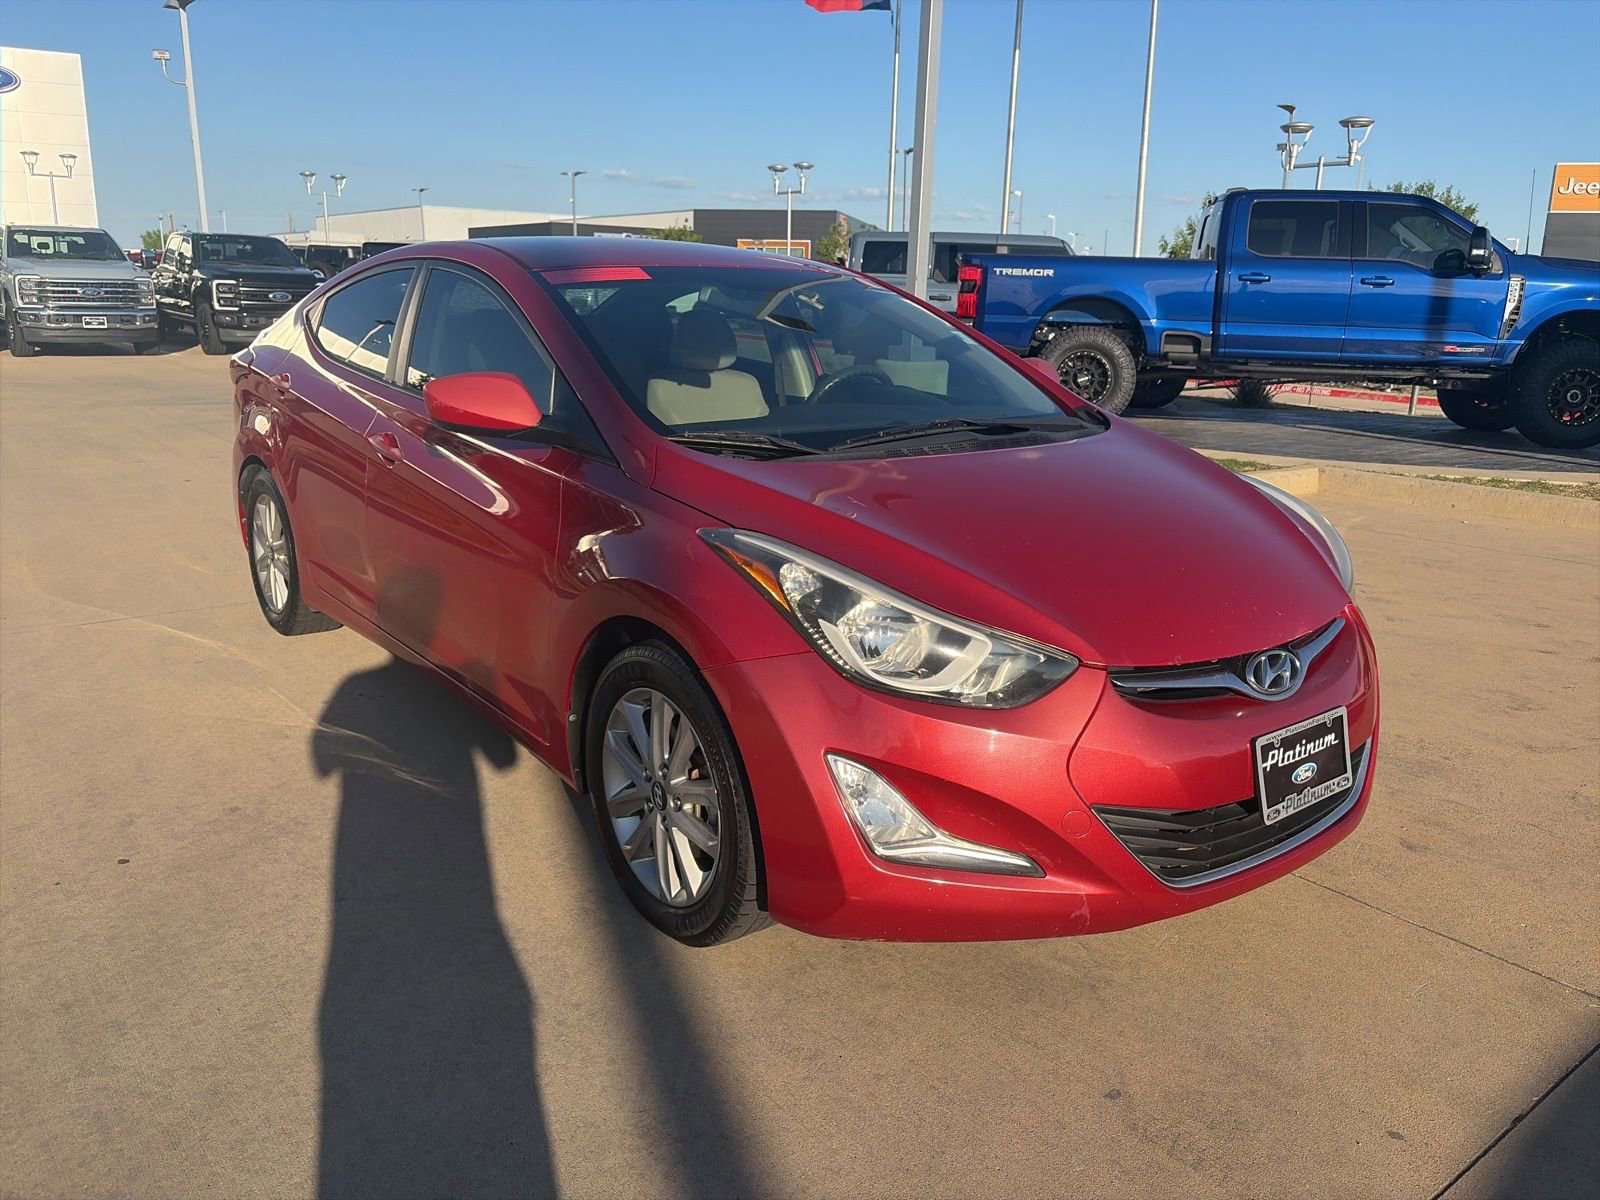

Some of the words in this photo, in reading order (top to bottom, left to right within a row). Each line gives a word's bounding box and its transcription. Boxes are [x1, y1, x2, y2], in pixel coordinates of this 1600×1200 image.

[1558, 177, 1600, 199] Jee
[993, 267, 1055, 277] TREMOR
[1262, 732, 1339, 771] Platinum
[1284, 784, 1336, 814] Platinum
